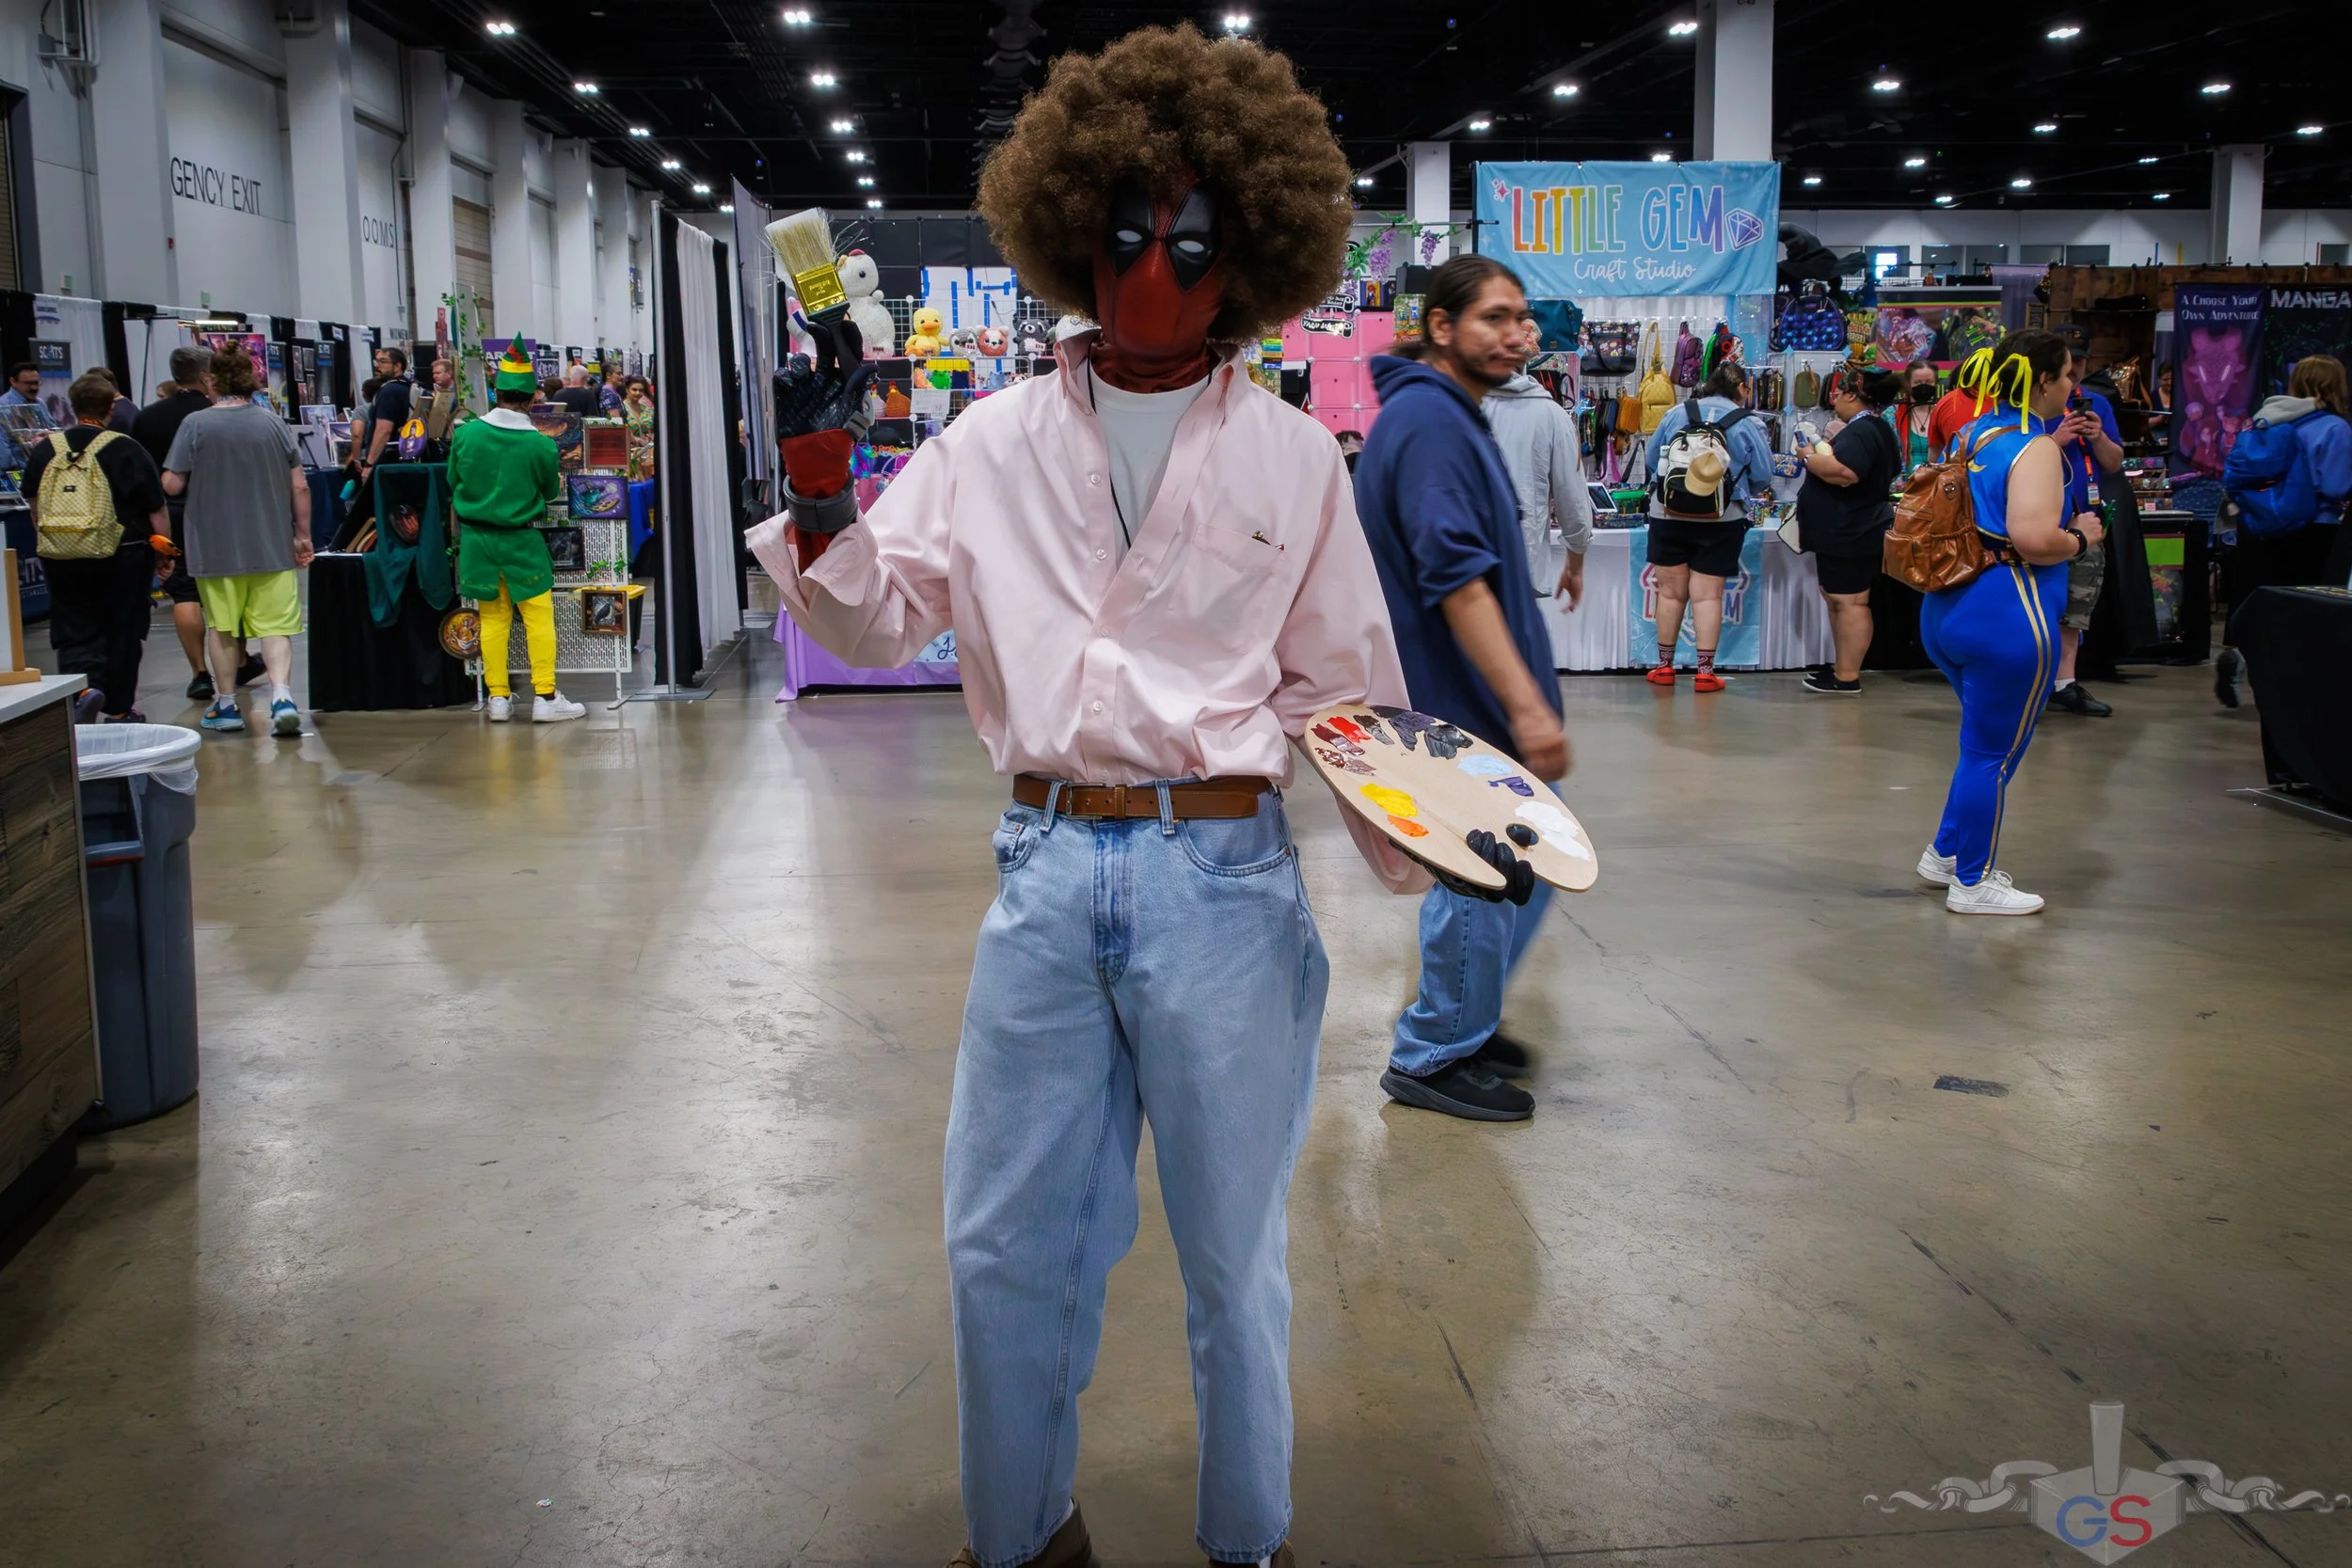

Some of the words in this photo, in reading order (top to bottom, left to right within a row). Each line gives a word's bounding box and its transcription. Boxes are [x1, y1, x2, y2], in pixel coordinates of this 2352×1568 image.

[231, 173, 262, 215] EXIT
[1511, 184, 1626, 255] LITTLE
[1640, 184, 1724, 254] GEM
[1574, 259, 1627, 282] Craft
[1633, 257, 1697, 280] Studio
[2182, 294, 2189, 306] A
[2270, 289, 2352, 309] MANGA
